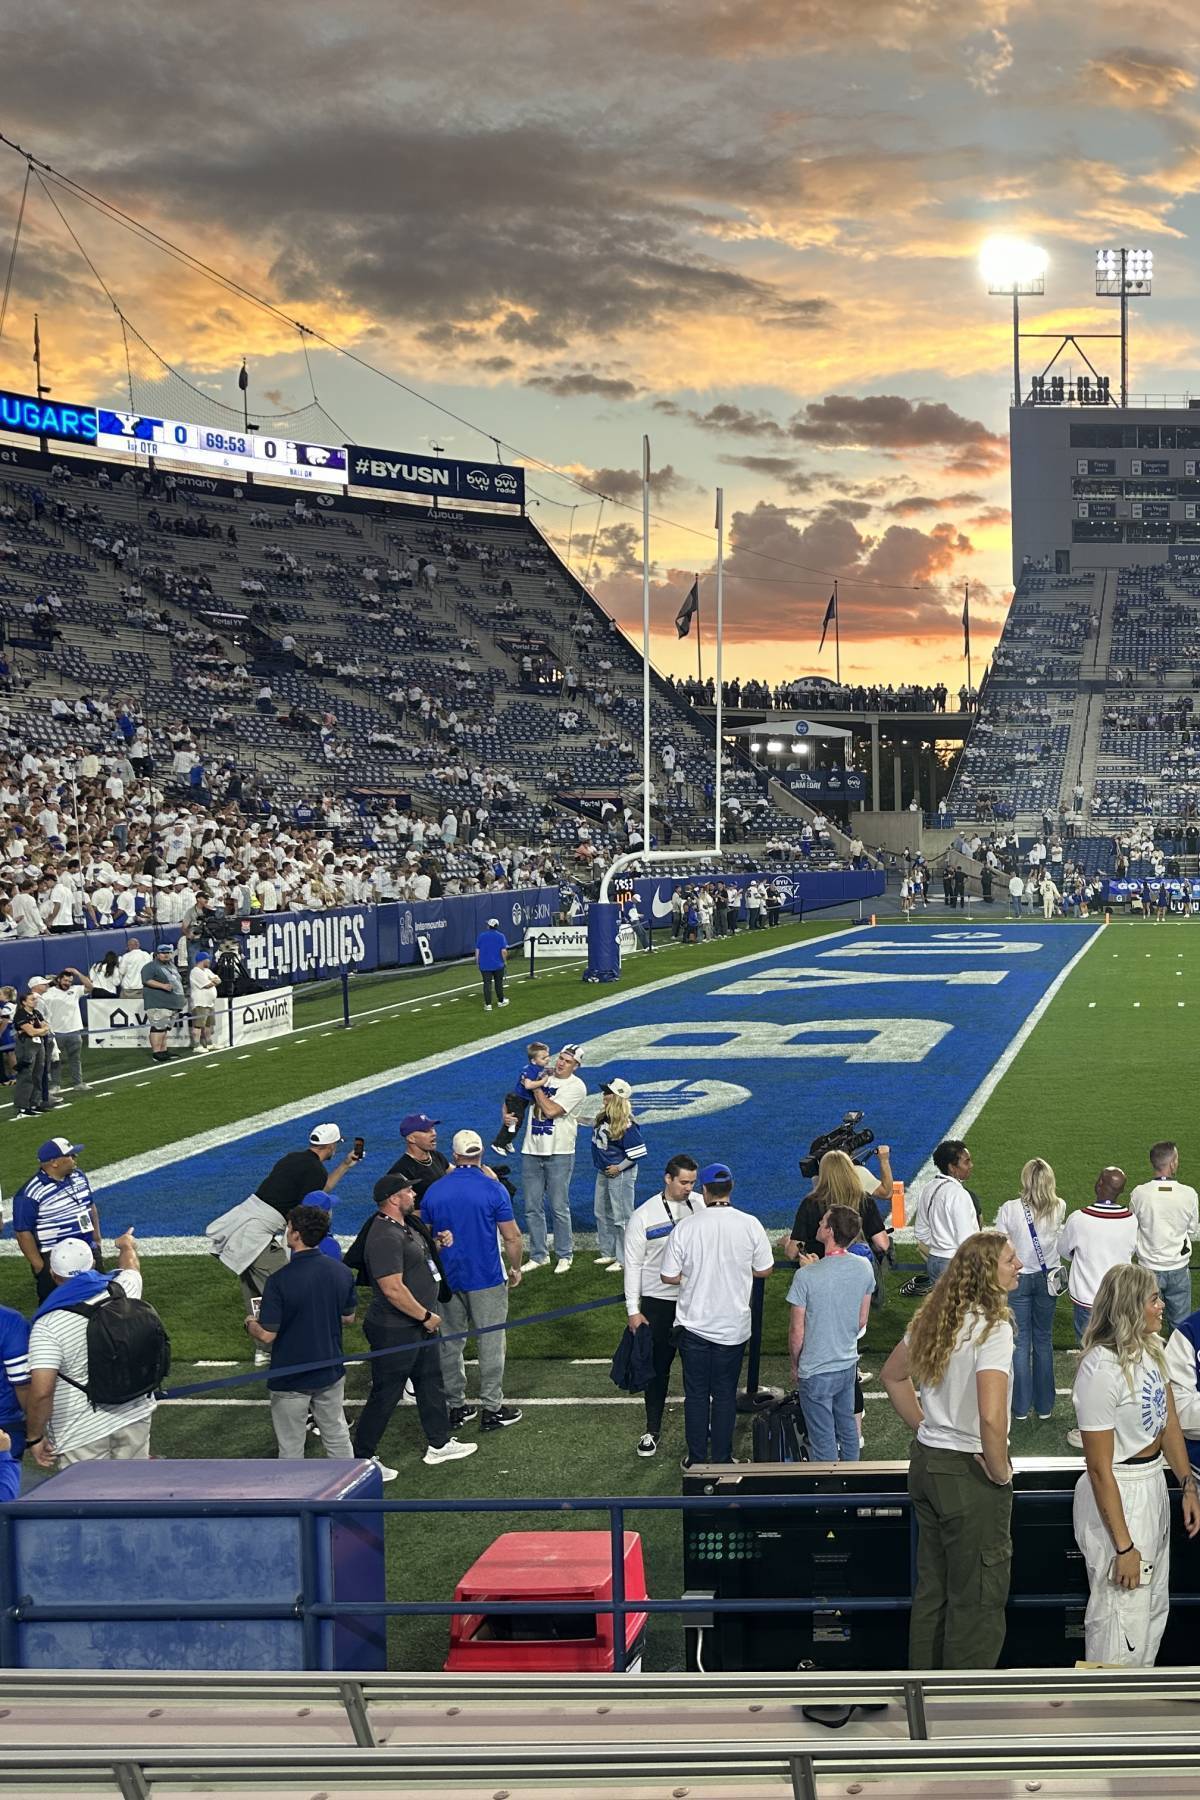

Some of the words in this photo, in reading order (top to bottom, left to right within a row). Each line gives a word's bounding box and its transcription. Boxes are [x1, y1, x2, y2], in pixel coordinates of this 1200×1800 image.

[174, 425, 187, 444] 0
[140, 441, 158, 455] QTR
[206, 432, 246, 453] 69:53
[264, 440, 276, 459] 0
[355, 459, 449, 485] #BYUSN
[212, 617, 233, 626] Portal
[512, 642, 530, 650] Portal
[580, 799, 600, 807] Portal
[1118, 882, 1138, 890] GO
[414, 919, 449, 931] Intermountain
[418, 935, 434, 965] B
